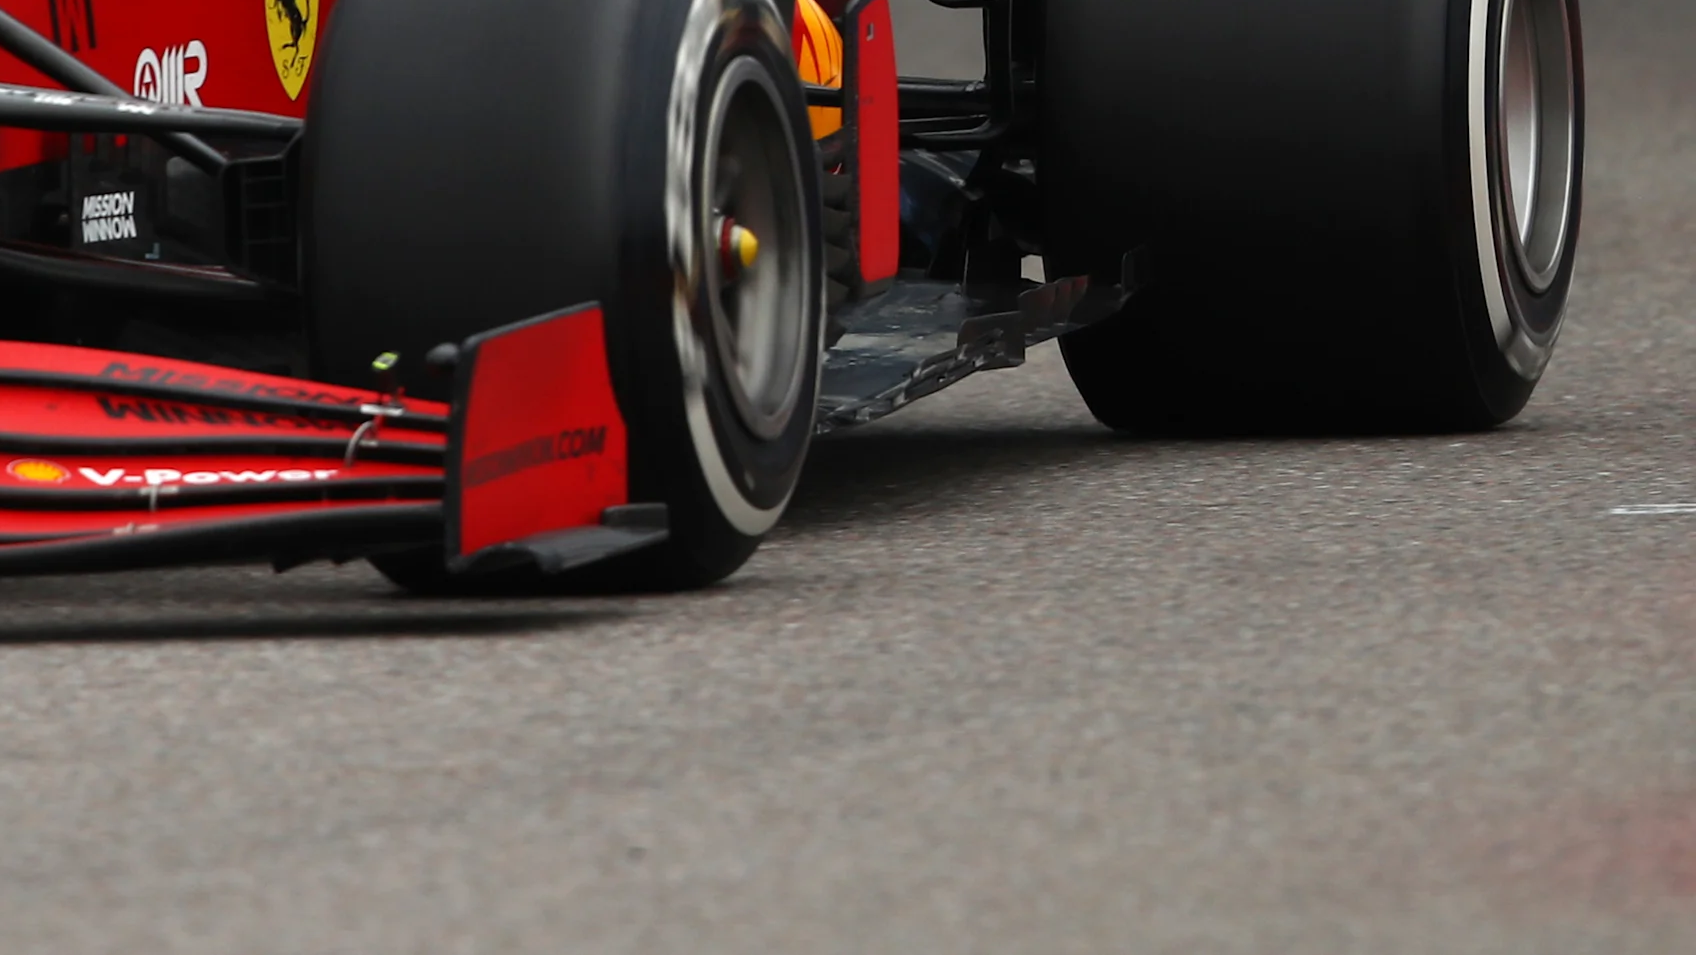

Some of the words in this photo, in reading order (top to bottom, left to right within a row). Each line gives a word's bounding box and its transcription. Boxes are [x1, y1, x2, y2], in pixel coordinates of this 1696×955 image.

[82, 191, 134, 219] MISSION
[82, 215, 137, 243] WINNOW
[78, 468, 338, 486] V-Power
